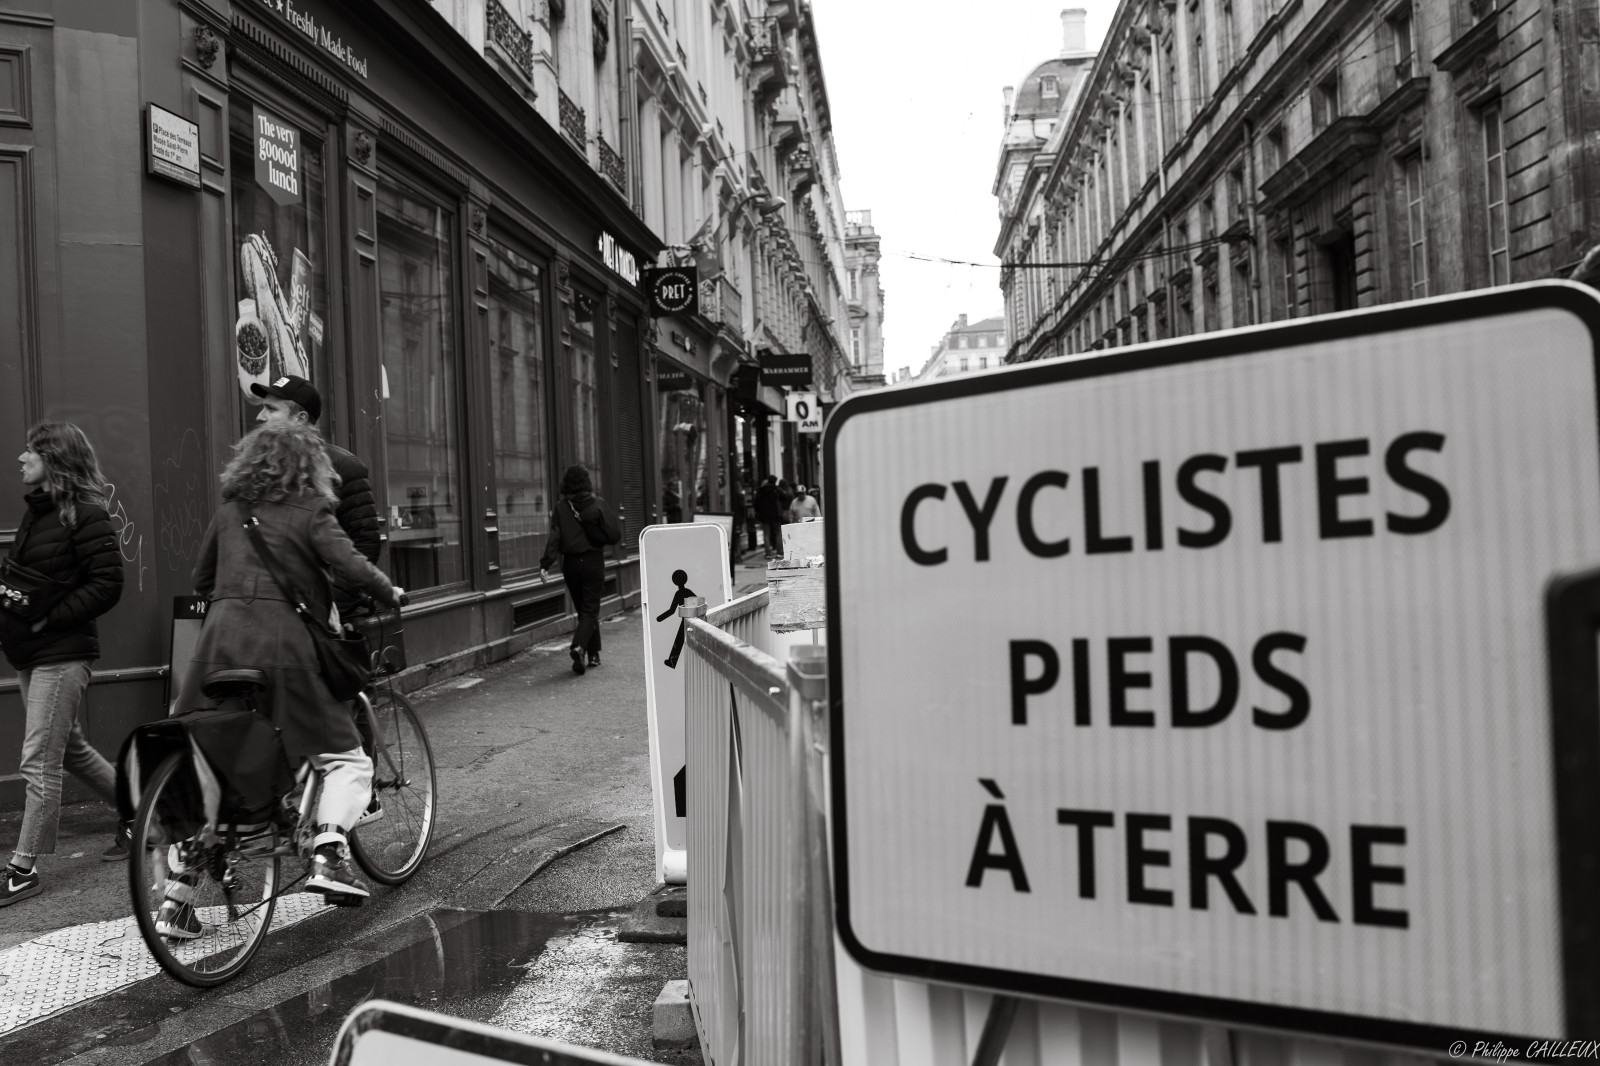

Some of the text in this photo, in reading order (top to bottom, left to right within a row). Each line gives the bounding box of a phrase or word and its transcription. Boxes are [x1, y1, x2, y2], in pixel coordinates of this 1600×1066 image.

[286, 0, 368, 79] Freshly Made Food
[258, 115, 295, 149] The very
[259, 137, 297, 172] gooood
[268, 160, 298, 195] lunch
[662, 284, 686, 300] PRET
[763, 366, 809, 375] WARHAMMER
[899, 430, 1453, 567] CYCLISTES
[1008, 630, 1312, 732] PIEDS
[964, 778, 1411, 931] À TERRE
